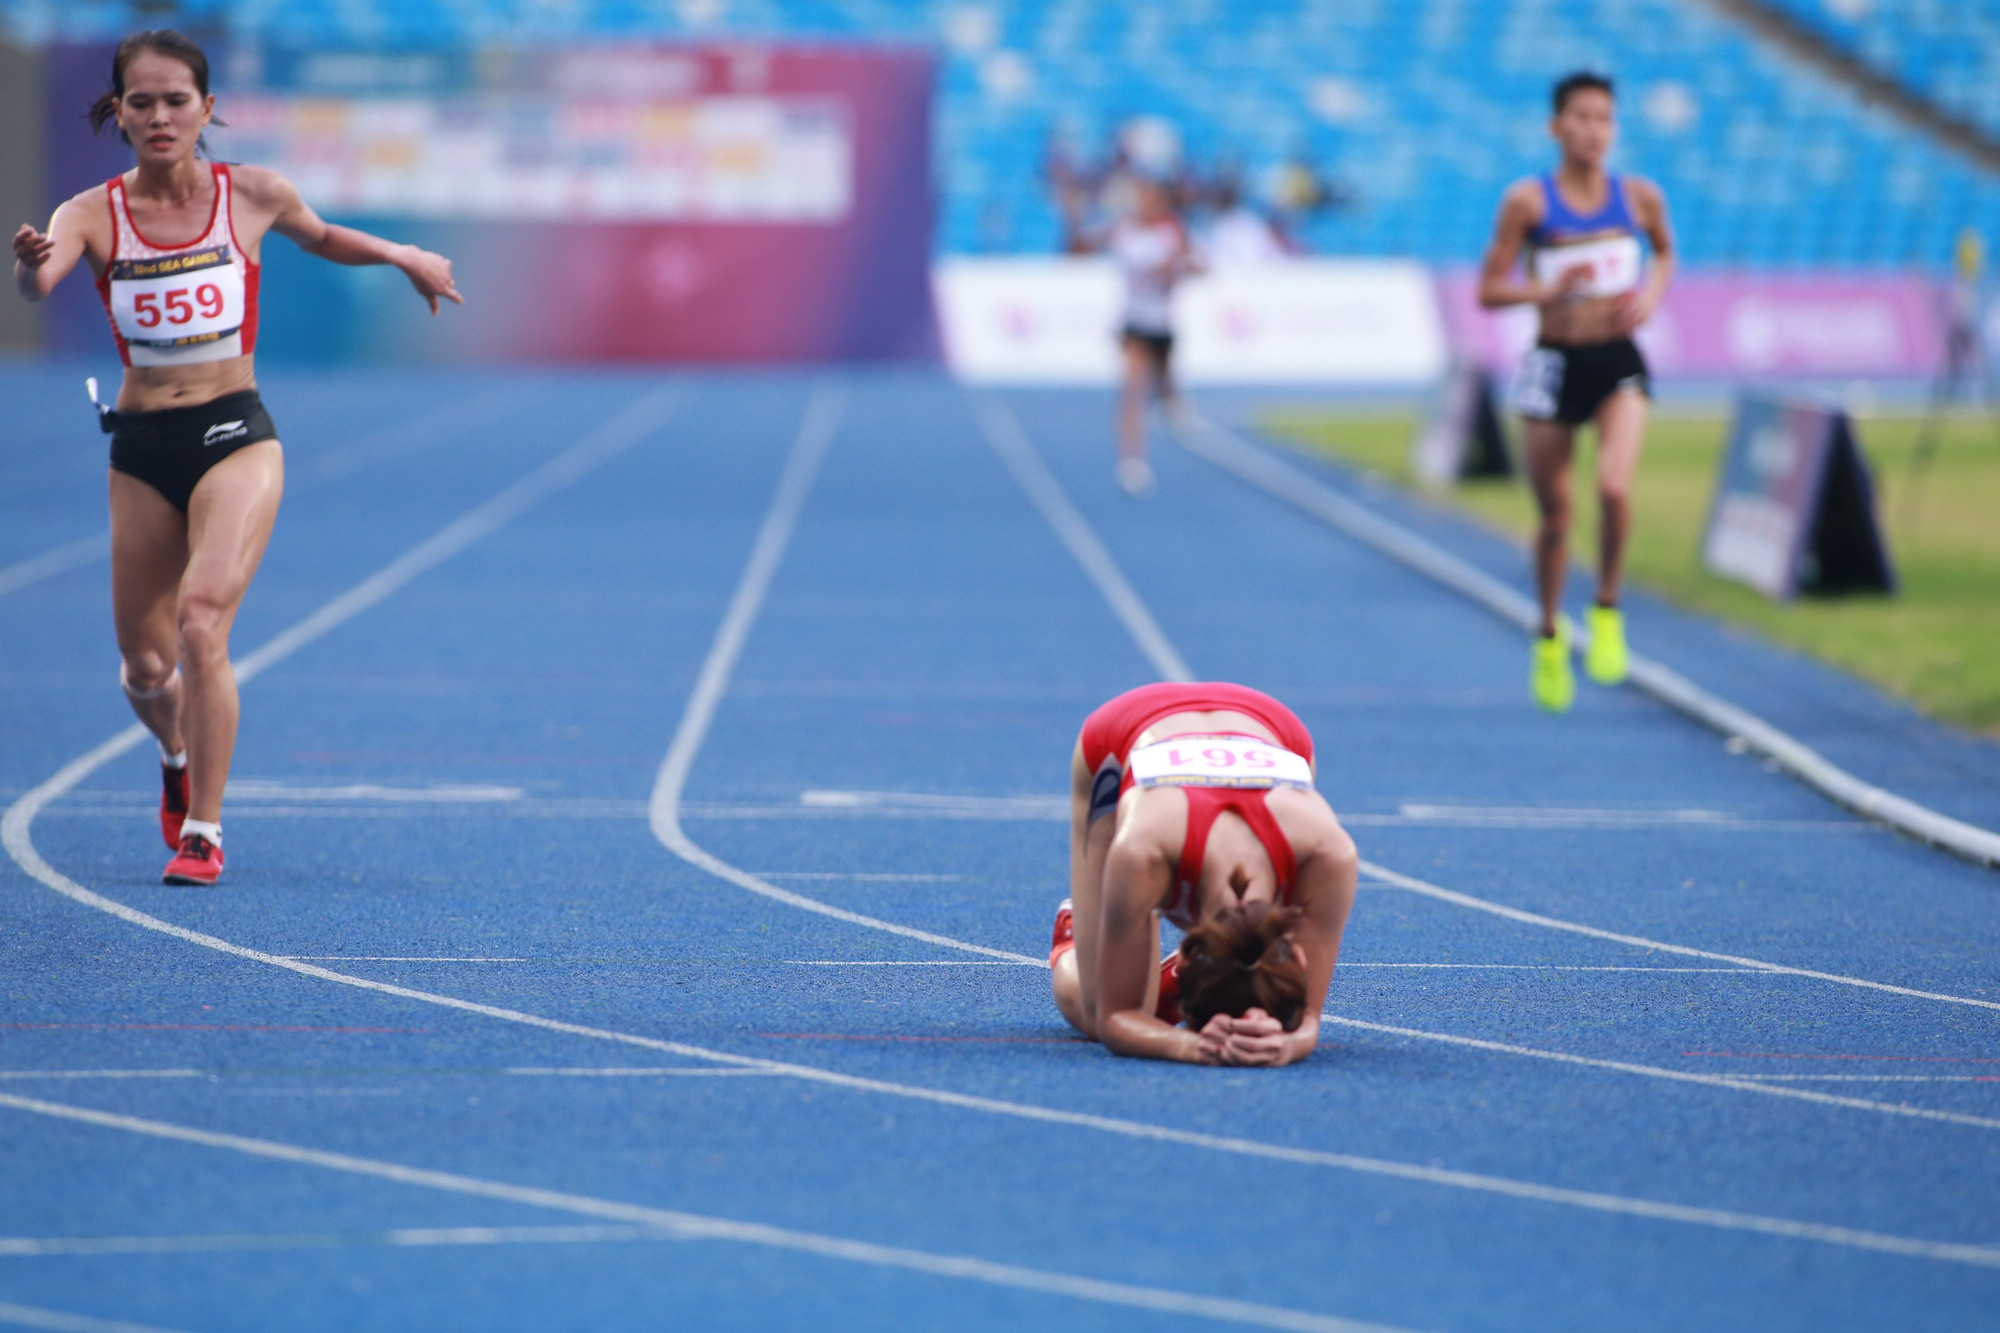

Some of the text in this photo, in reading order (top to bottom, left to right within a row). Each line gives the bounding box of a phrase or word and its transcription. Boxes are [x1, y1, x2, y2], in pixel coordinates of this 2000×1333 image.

[158, 259, 181, 272] SEA
[181, 251, 220, 269] GAMES
[134, 283, 224, 328] 559
[1168, 748, 1276, 768] 561
